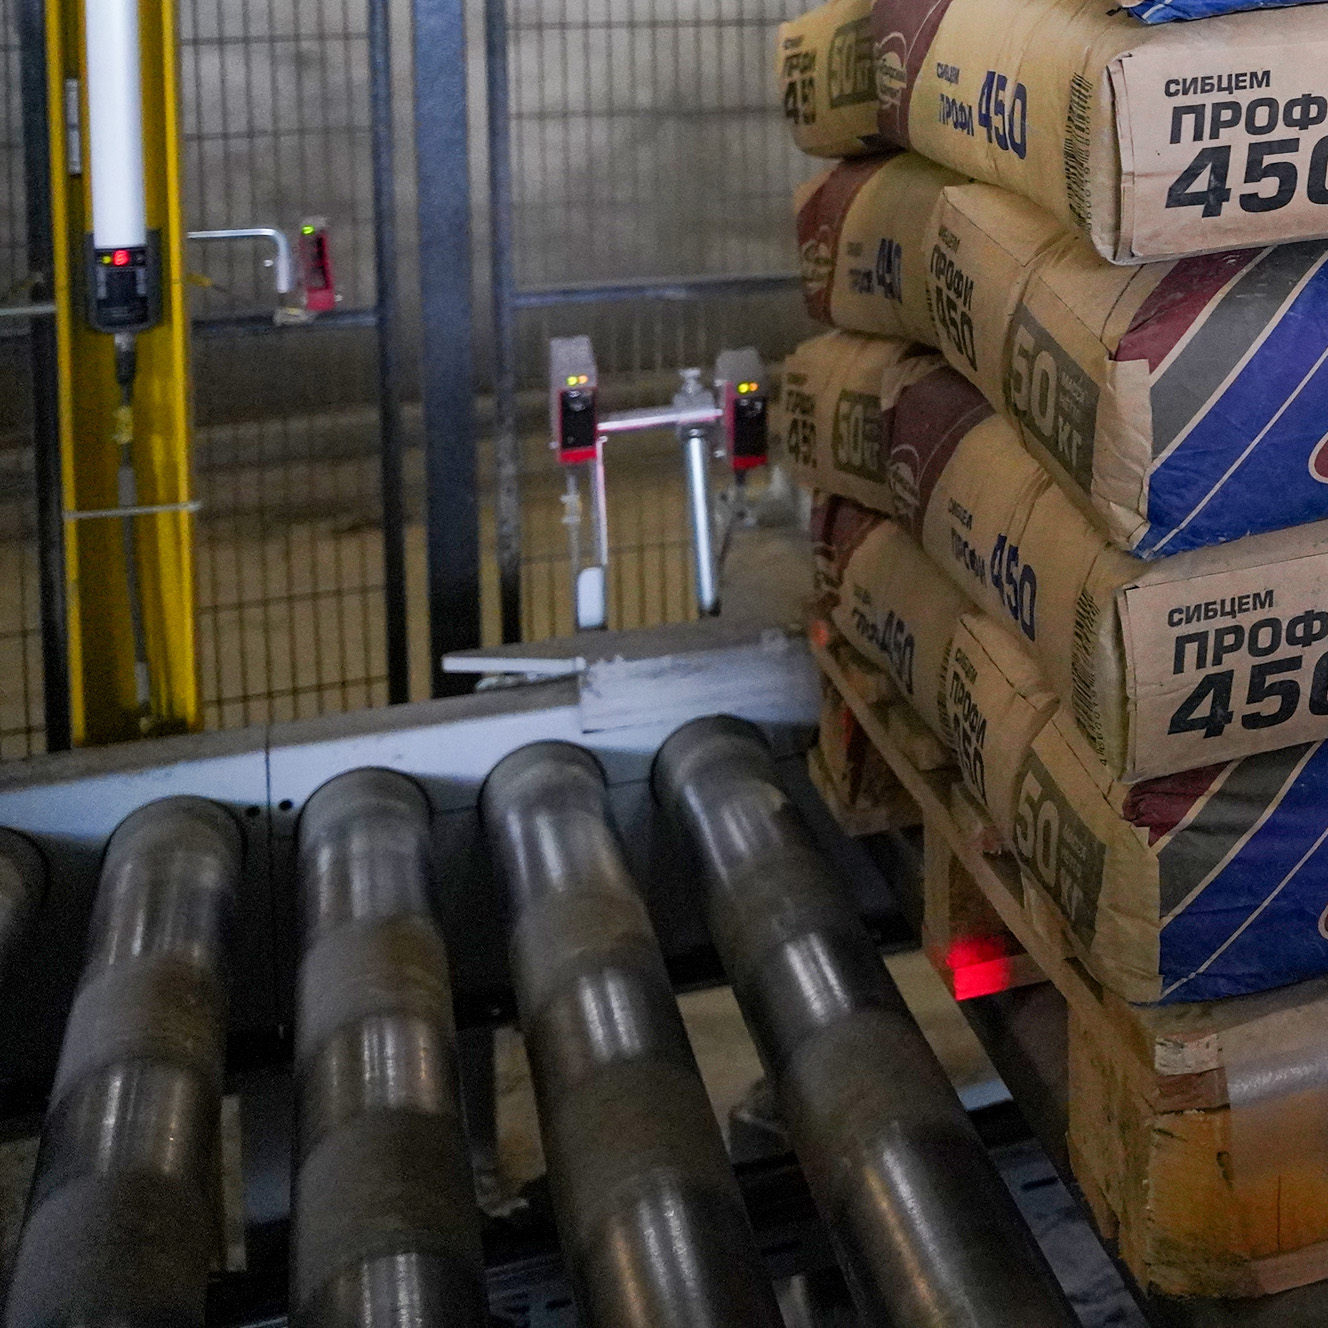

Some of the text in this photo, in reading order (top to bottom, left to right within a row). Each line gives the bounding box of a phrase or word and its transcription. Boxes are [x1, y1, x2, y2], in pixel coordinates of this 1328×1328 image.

[978, 70, 1027, 159] 450
[1164, 69, 1271, 97] СИБЦЕМ
[930, 244, 975, 307] ПРОФИ
[936, 286, 977, 372] 450
[1010, 326, 1057, 436] 50
[991, 533, 1036, 642] 450
[1167, 589, 1274, 628] СИБЦЕМ
[950, 670, 986, 750] ПРОФИ
[1016, 770, 1059, 888] 50
